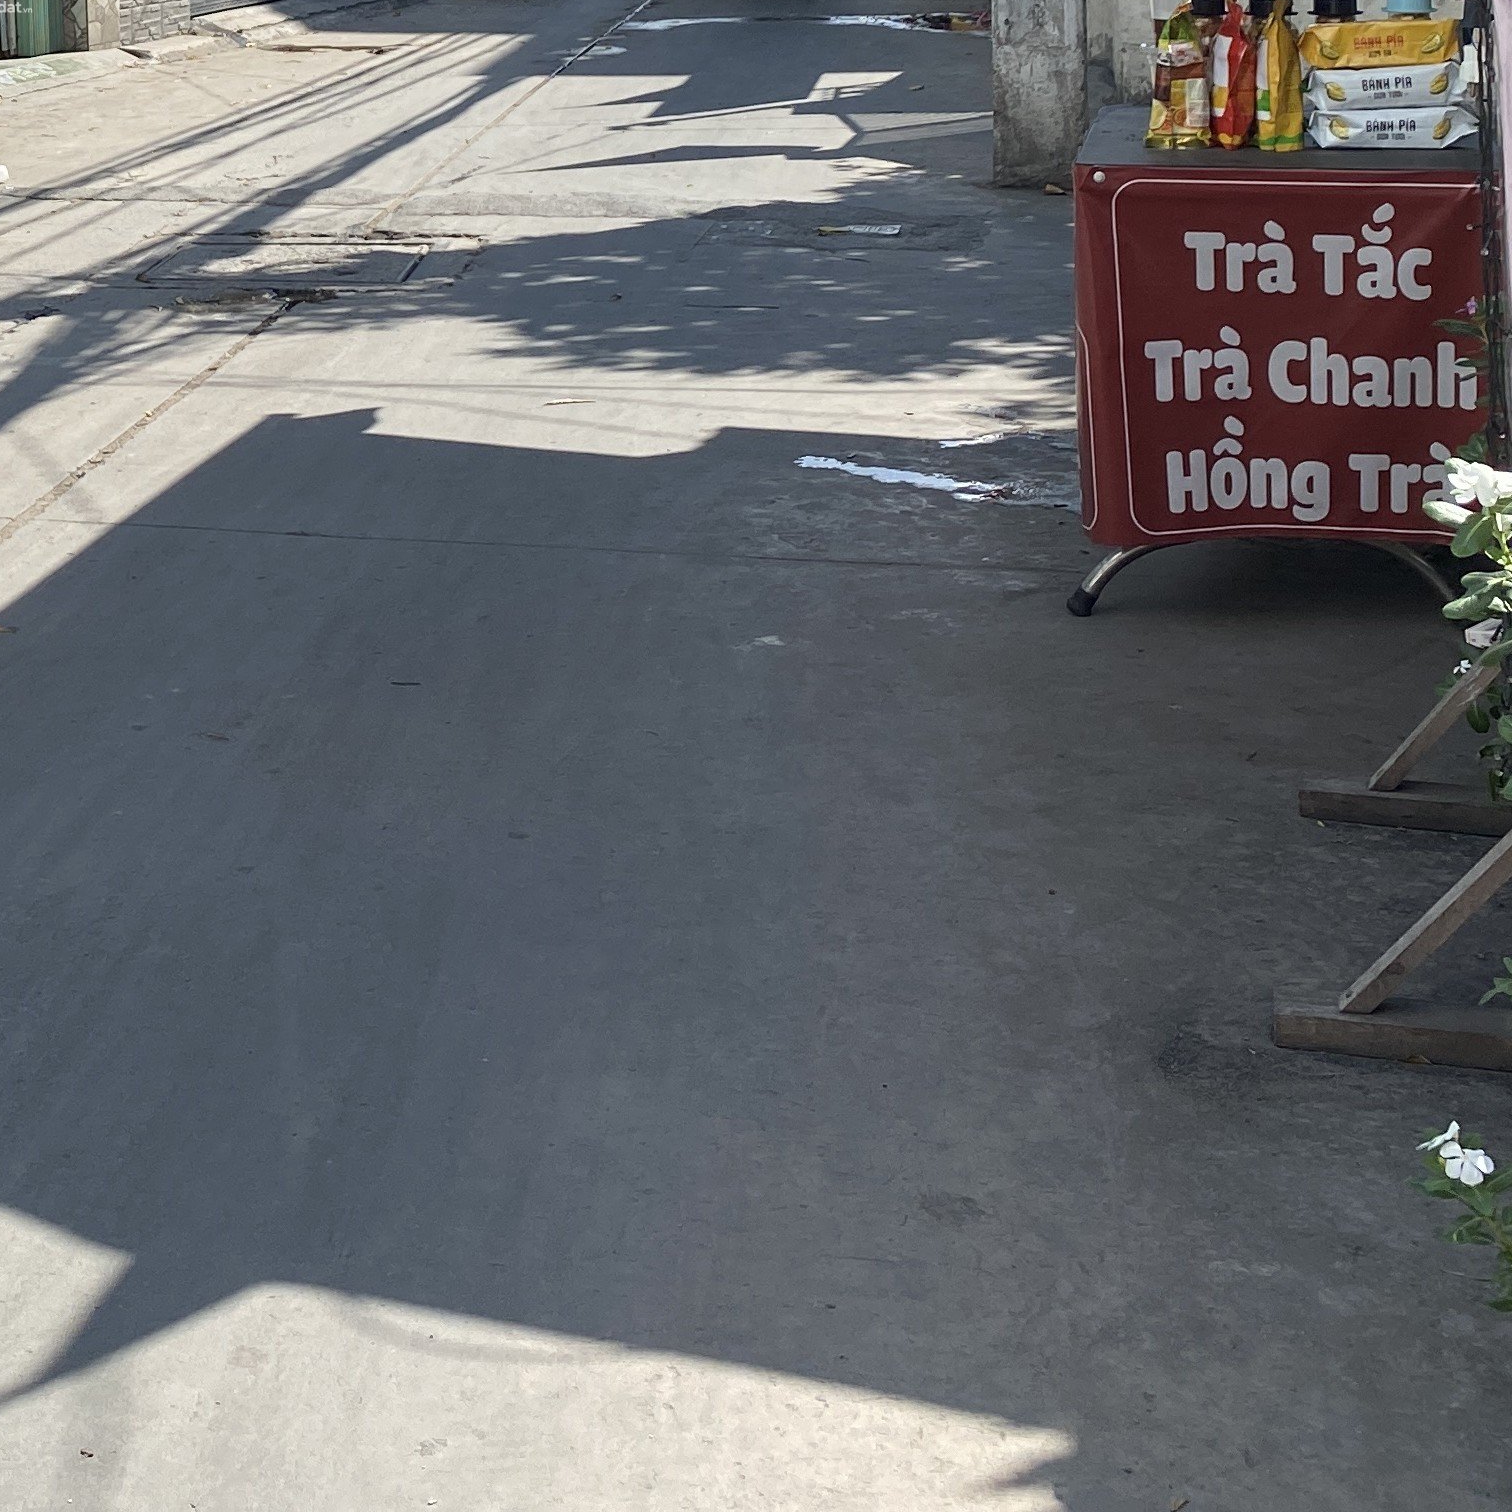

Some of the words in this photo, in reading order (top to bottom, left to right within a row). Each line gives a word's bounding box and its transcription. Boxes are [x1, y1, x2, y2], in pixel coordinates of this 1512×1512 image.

[1361, 76, 1390, 92] BÁNH
[1394, 74, 1413, 89] PÍA
[1366, 118, 1395, 133] BÁNH
[1398, 117, 1416, 132] PÍA
[1184, 220, 1297, 295] Trà
[1311, 203, 1433, 302] Tắc
[1144, 326, 1252, 404] Trà
[1268, 337, 1478, 411] Chanh
[1165, 416, 1332, 523] Hồng
